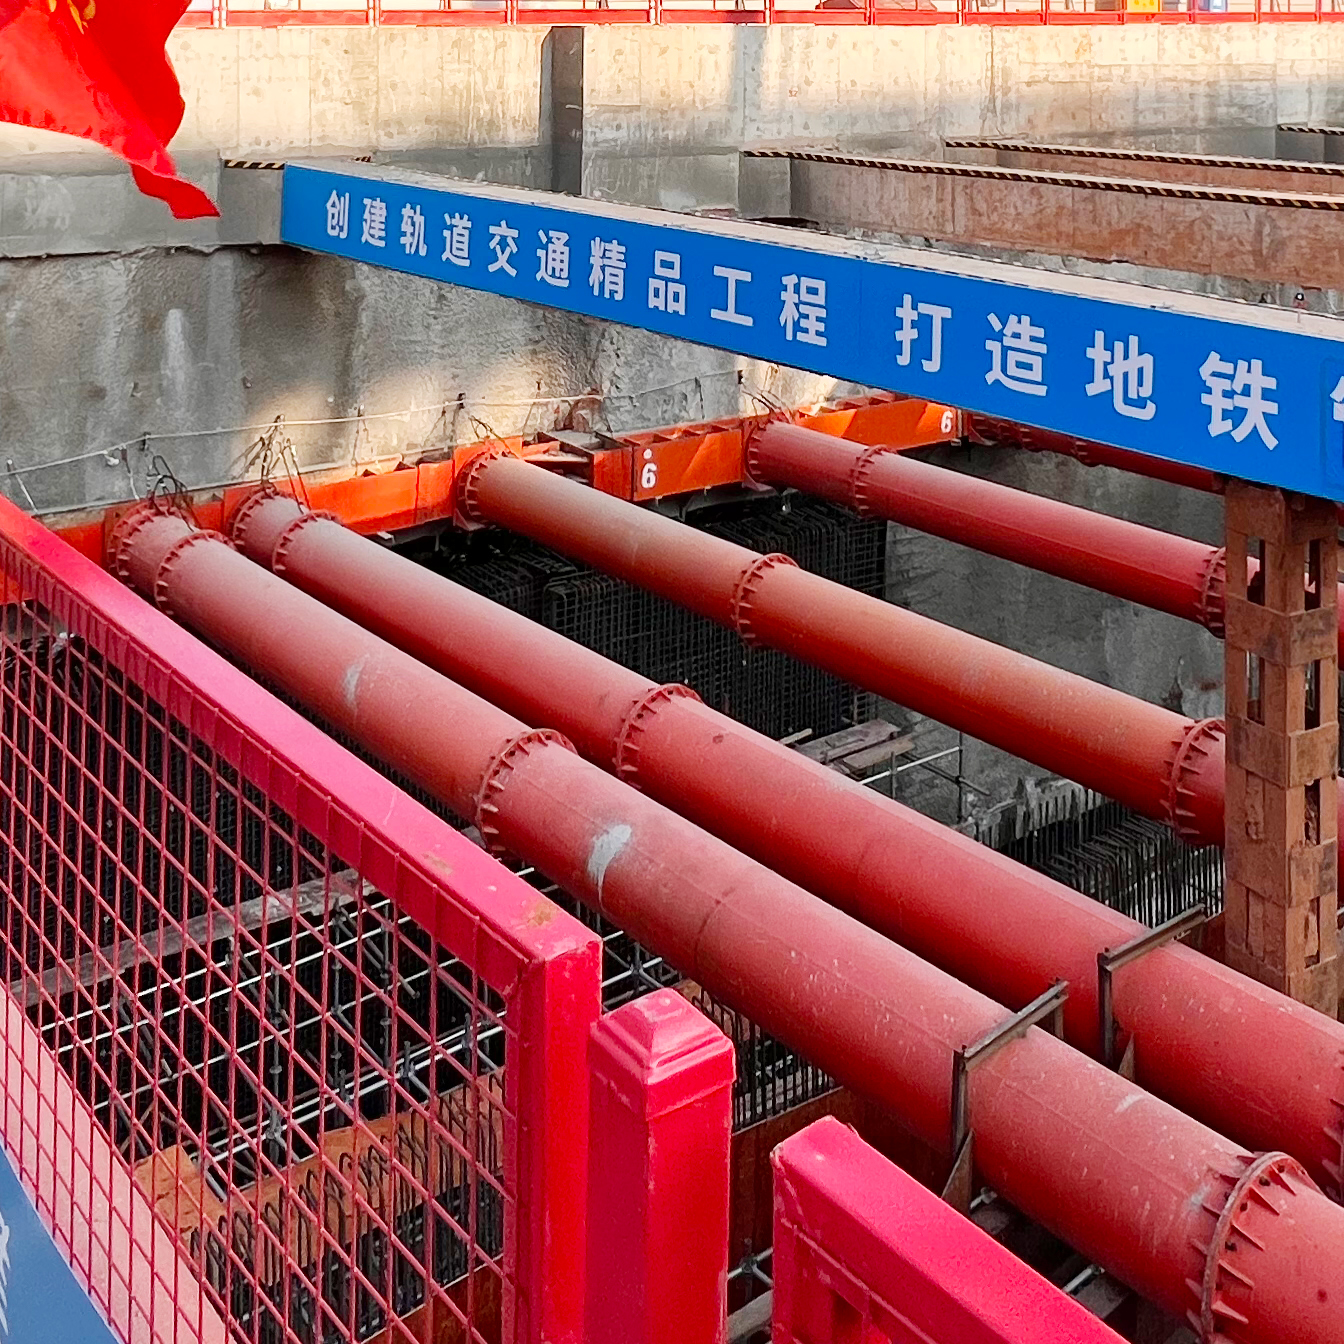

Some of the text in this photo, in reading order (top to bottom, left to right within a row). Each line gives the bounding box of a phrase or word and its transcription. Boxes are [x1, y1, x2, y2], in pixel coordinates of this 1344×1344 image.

[325, 189, 828, 348] 创建轨道交通精品工程
[940, 410, 954, 434] 6
[641, 462, 657, 489] 6
